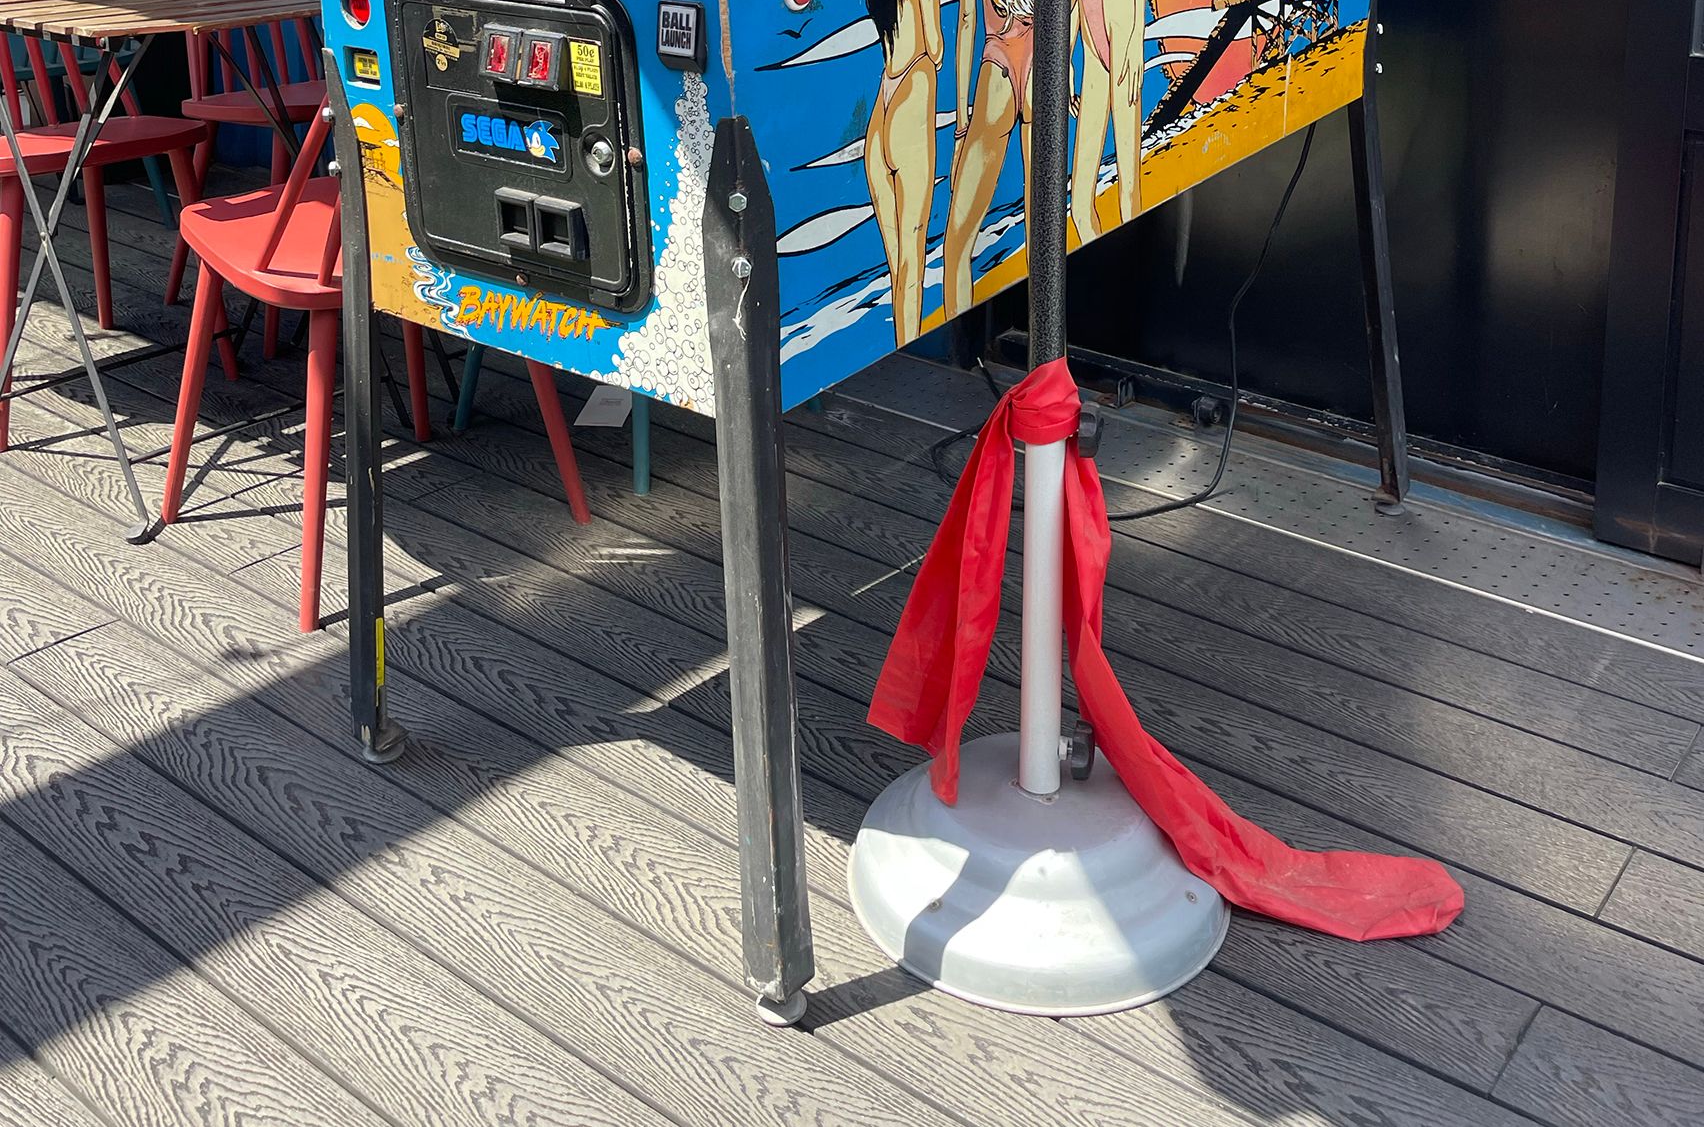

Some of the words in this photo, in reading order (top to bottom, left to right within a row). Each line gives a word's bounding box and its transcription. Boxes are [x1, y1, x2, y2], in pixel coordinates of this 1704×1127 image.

[662, 11, 692, 31] BALL
[661, 28, 691, 49] LAUNCH
[461, 113, 526, 151] SEGA
[456, 286, 622, 342] BAYWATCH
